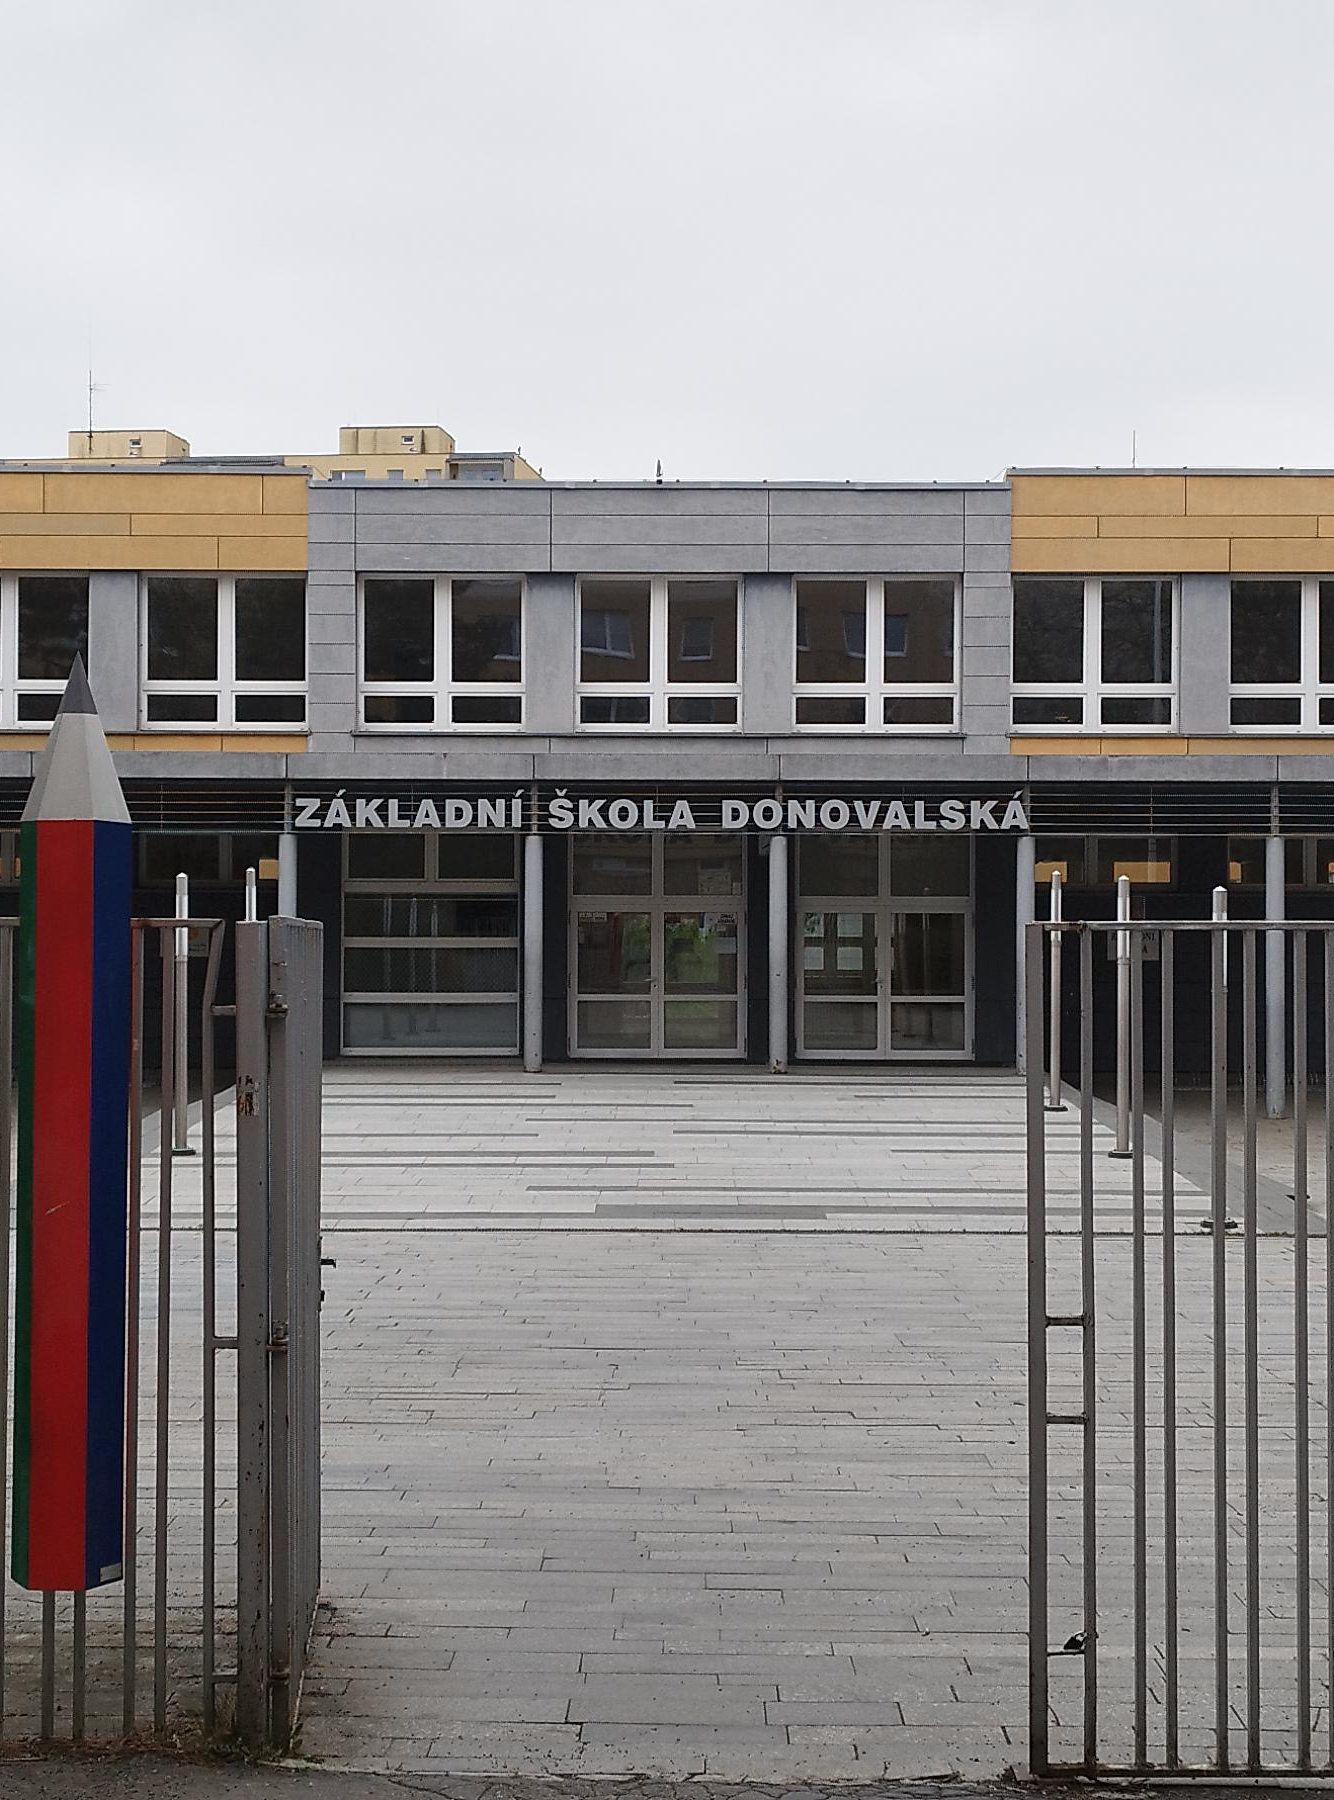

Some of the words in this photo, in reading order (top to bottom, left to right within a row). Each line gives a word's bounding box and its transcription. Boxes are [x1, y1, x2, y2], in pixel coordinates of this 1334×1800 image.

[295, 789, 524, 828] ZÁKLADNÍ
[548, 788, 696, 829] ŠKOLA
[721, 789, 1029, 830] DONOVALSKÁ
